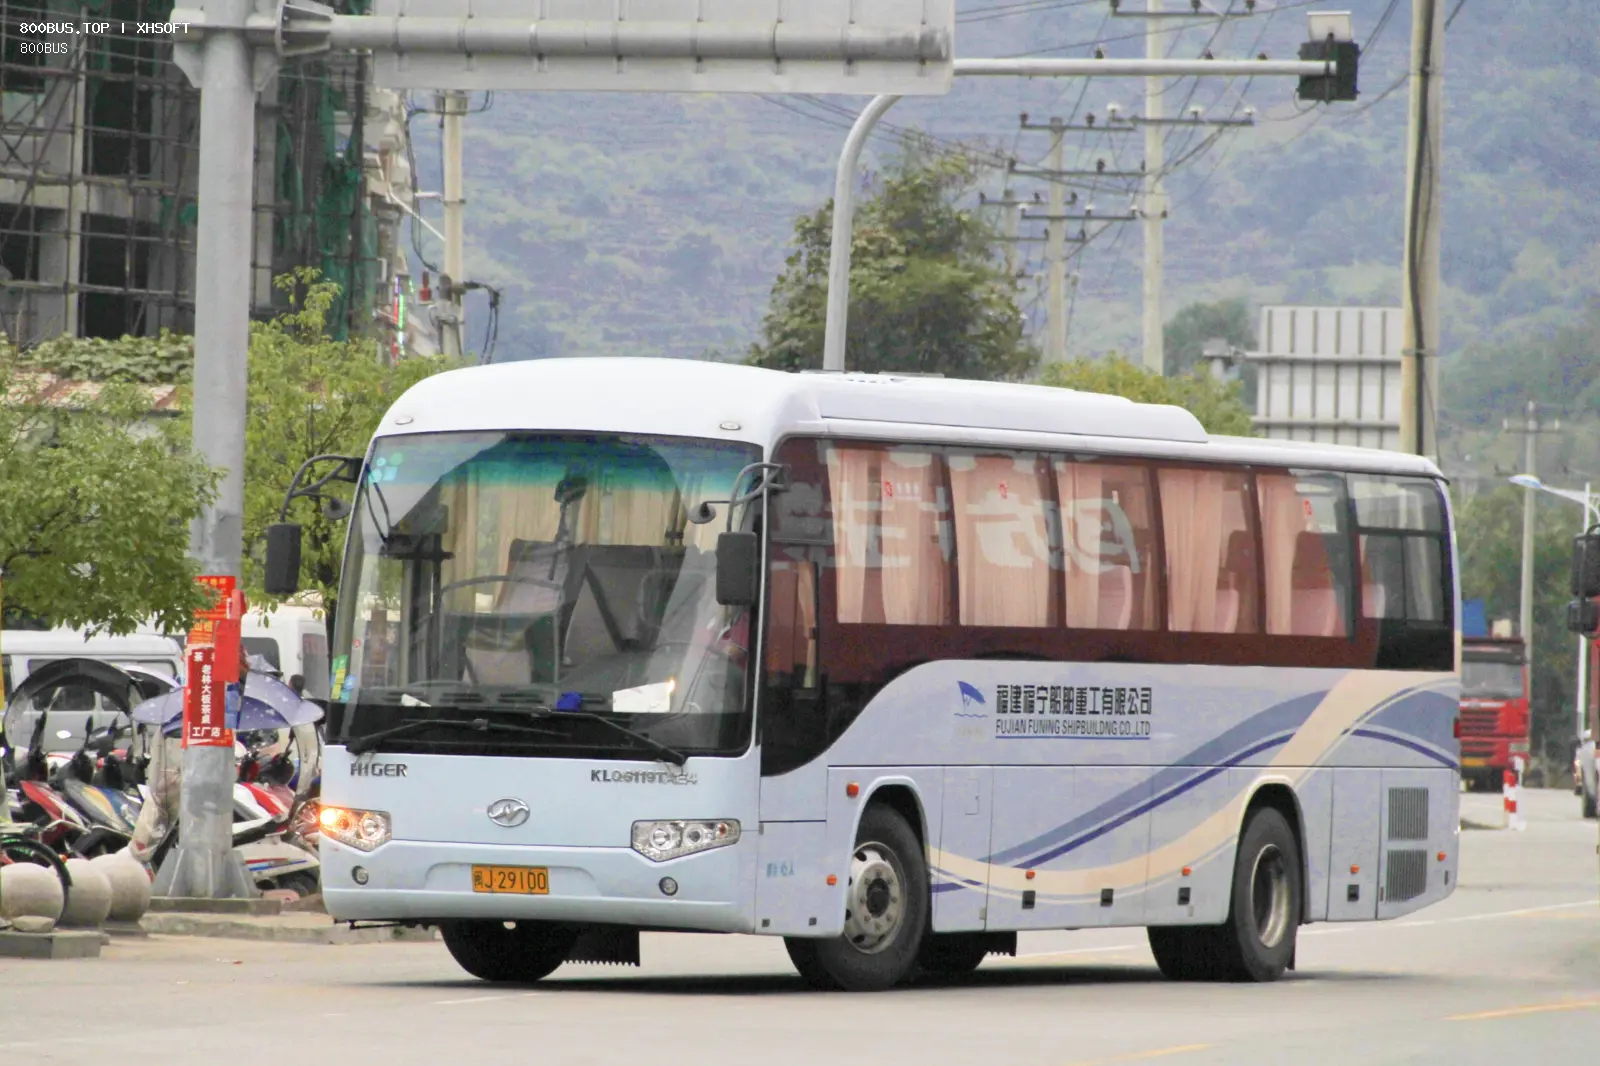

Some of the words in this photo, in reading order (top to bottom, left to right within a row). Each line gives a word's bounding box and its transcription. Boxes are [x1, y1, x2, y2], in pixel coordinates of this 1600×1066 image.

[192, 726, 221, 737] 工厂店
[996, 719, 1027, 734] FUJIAN
[1028, 719, 1060, 734] FUNING
[350, 763, 408, 777] HIGER
